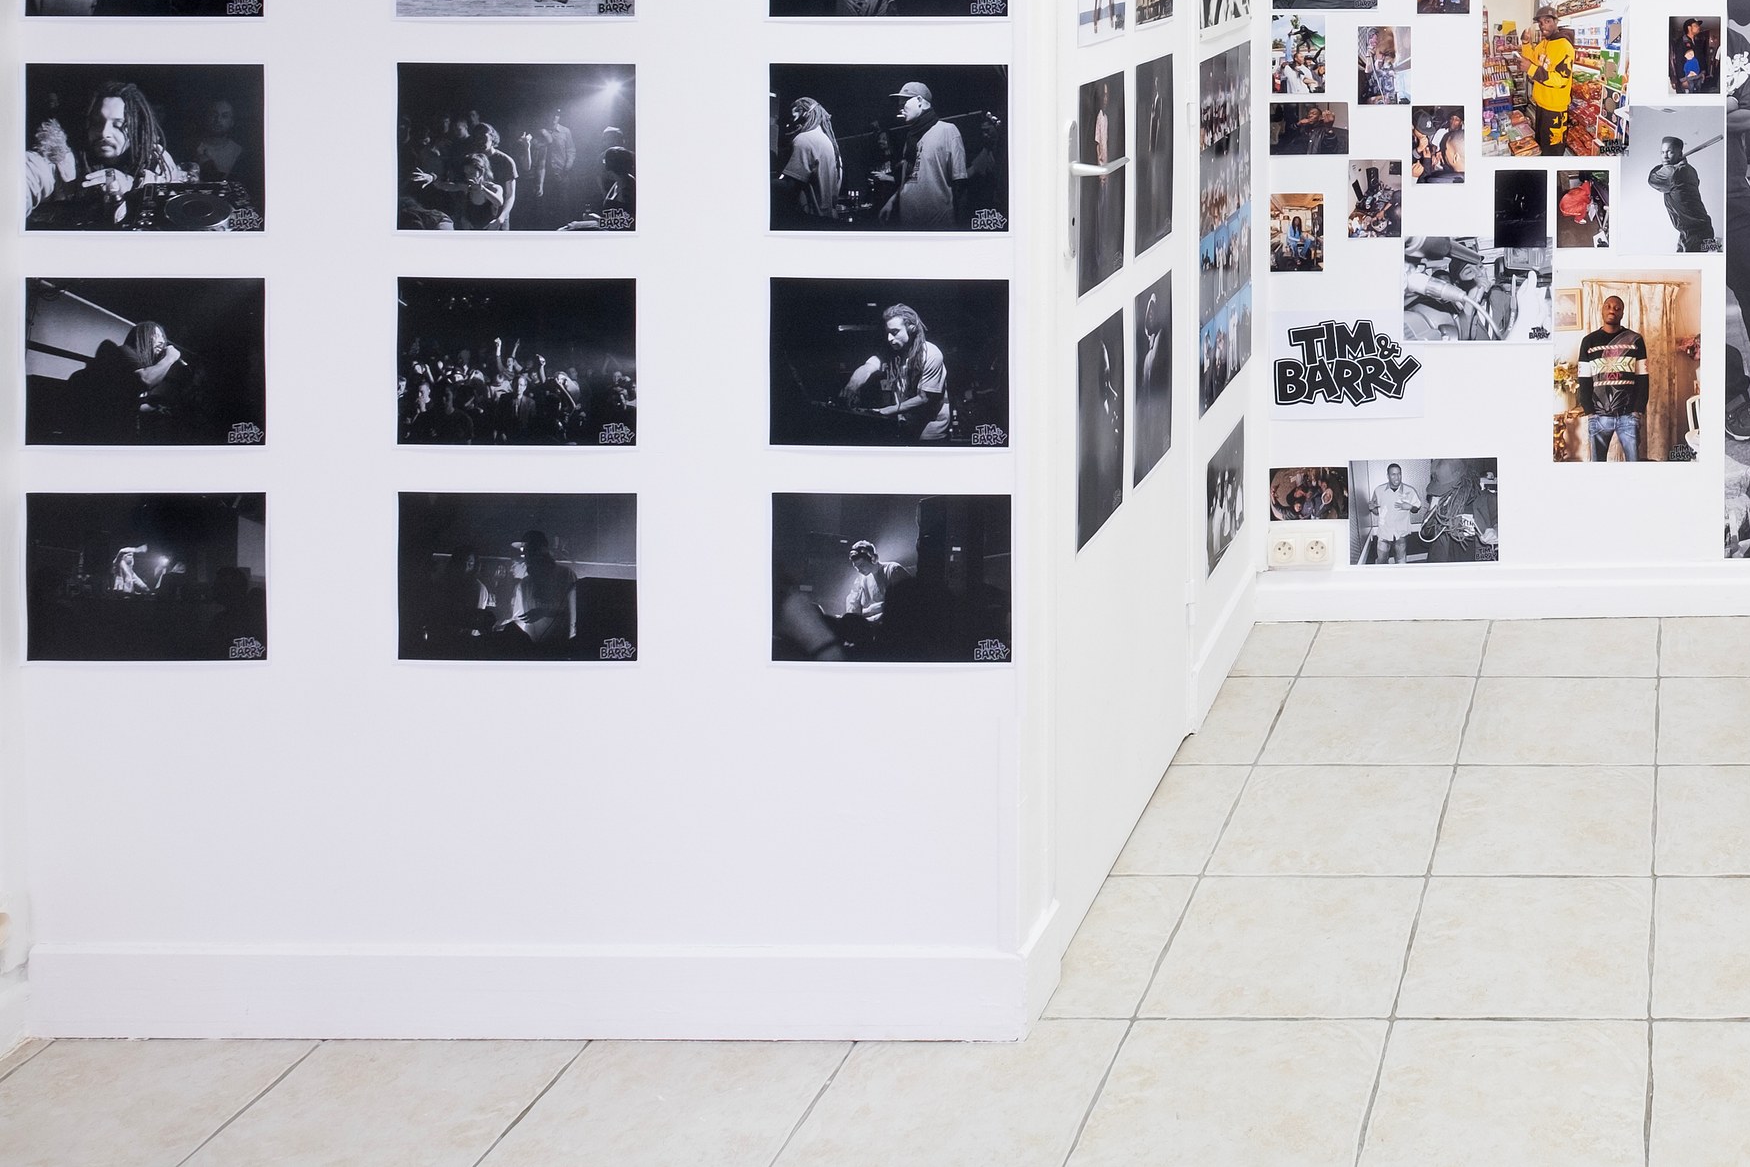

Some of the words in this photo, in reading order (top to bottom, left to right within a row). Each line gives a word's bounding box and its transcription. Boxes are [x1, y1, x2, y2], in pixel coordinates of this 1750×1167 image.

[227, 2, 262, 15] BARRY
[599, 2, 631, 14] BARRY
[970, 2, 1006, 15] BARRY
[600, 217, 635, 229] BARRY
[972, 217, 1007, 230] BARRY
[1274, 353, 1423, 407] BARRY
[228, 431, 264, 444] BARRY
[599, 432, 635, 444] BARRY
[972, 433, 1007, 445] BARRY
[229, 646, 265, 659] BARRY
[600, 647, 636, 659] BARRY
[974, 648, 1010, 661] BARRY
